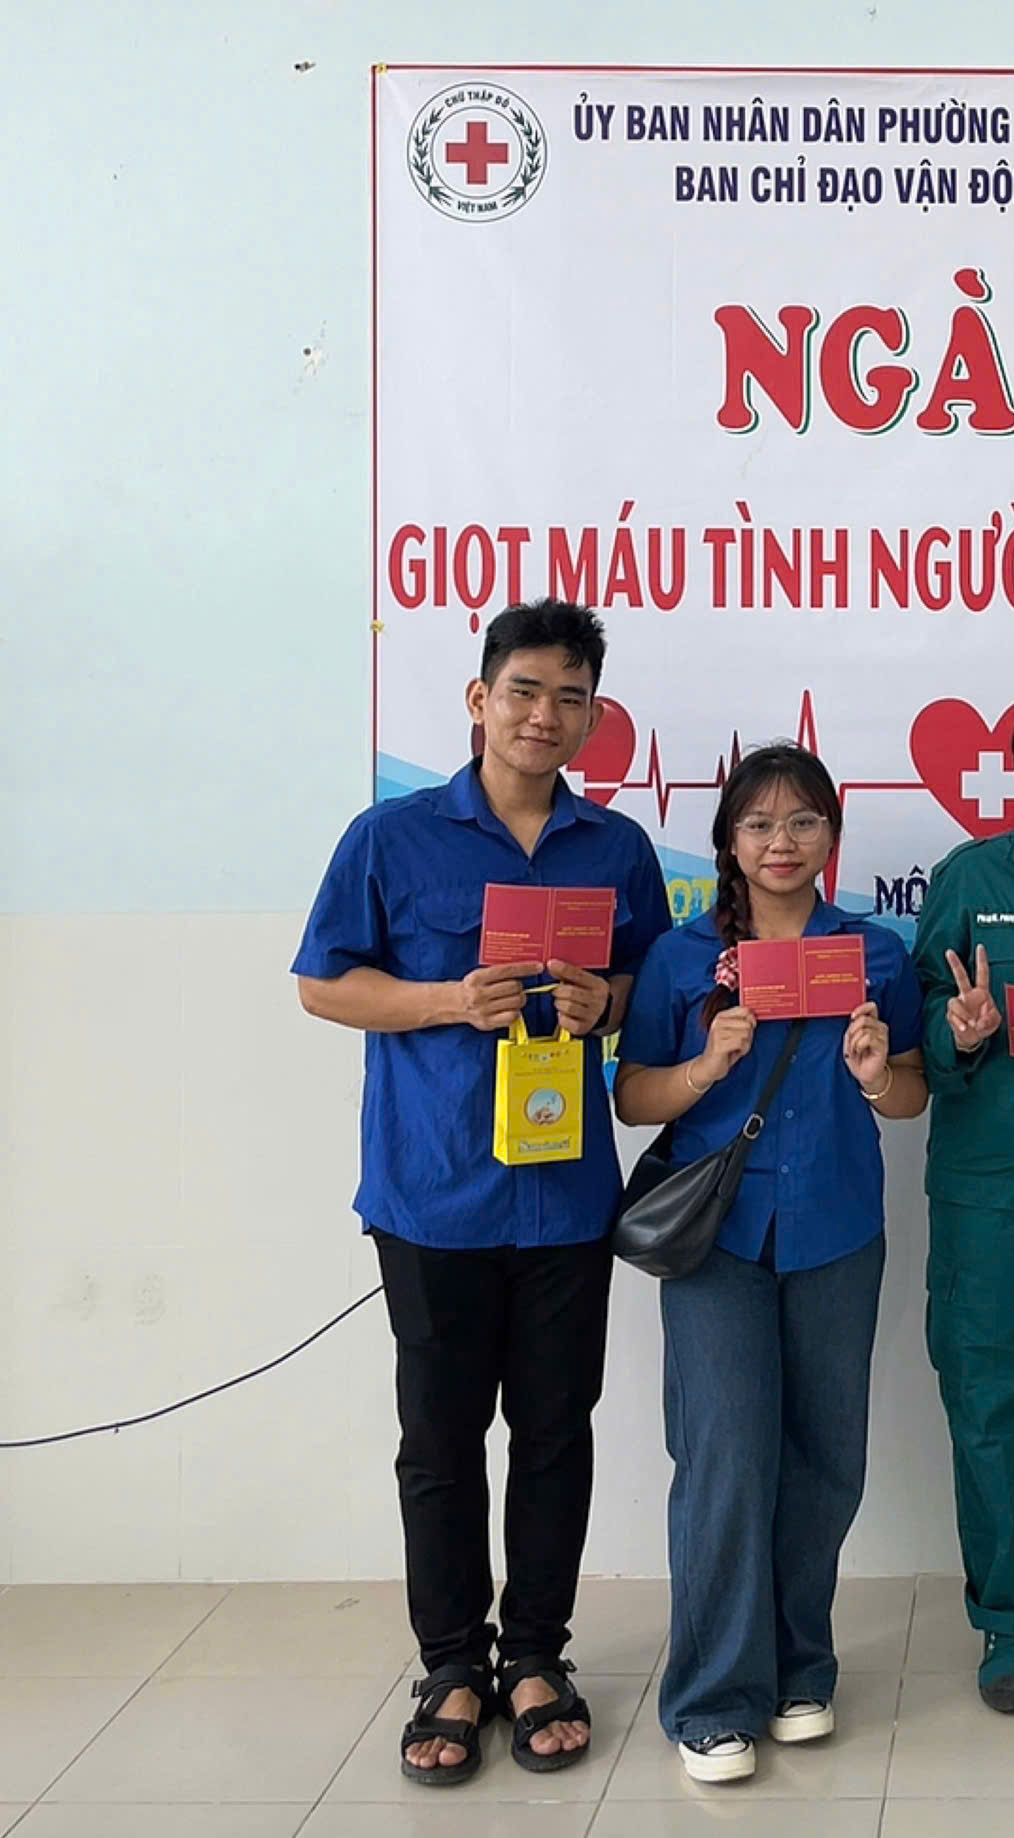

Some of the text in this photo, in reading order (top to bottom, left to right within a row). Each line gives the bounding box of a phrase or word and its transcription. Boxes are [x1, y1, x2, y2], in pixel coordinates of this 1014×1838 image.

[574, 90, 616, 141] ỦY
[627, 105, 690, 141] BAN
[703, 96, 789, 142] NHÂN
[802, 96, 866, 143] DÂN
[878, 95, 1010, 144] PHƯỜNG
[675, 166, 738, 202] BAN
[751, 155, 806, 203] CHỈ
[816, 167, 883, 212] ĐẠO
[893, 158, 957, 213] VẬN
[388, 524, 531, 633] GIỌT
[548, 500, 686, 612] MÁU
[703, 501, 849, 609] TÌNH
[874, 864, 928, 923] MỘ
